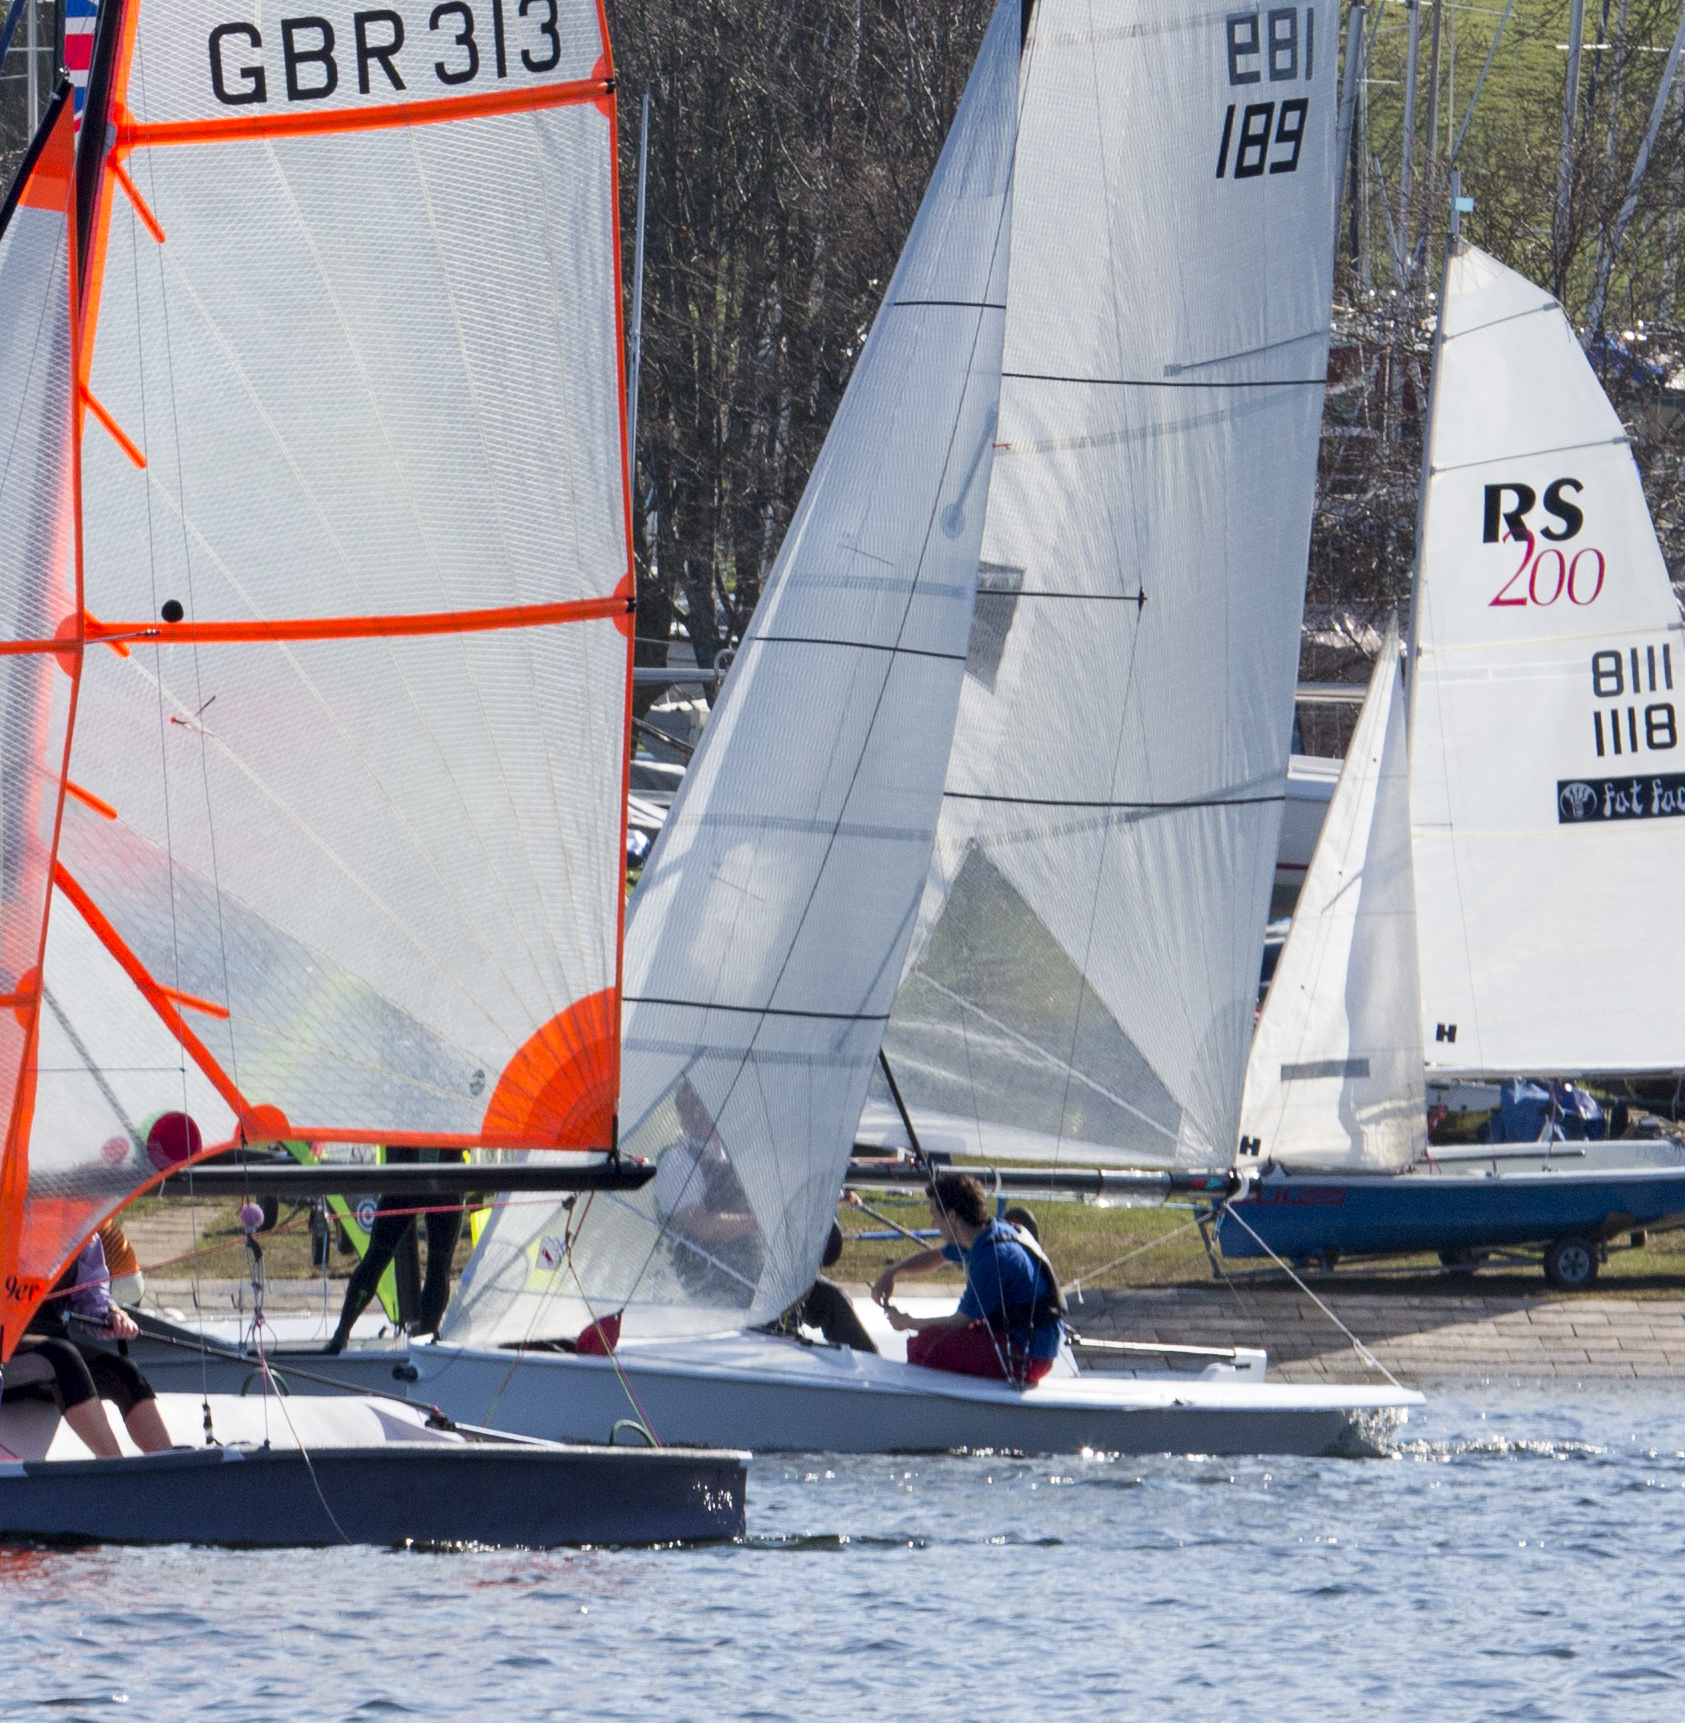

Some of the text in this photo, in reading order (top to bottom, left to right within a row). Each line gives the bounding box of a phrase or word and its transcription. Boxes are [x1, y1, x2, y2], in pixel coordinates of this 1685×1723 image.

[1215, 97, 1310, 179] 189
[1482, 477, 1585, 544] RS
[1487, 528, 1606, 607] 200
[1593, 702, 1678, 758] 1118
[1602, 779, 1644, 817] fat
